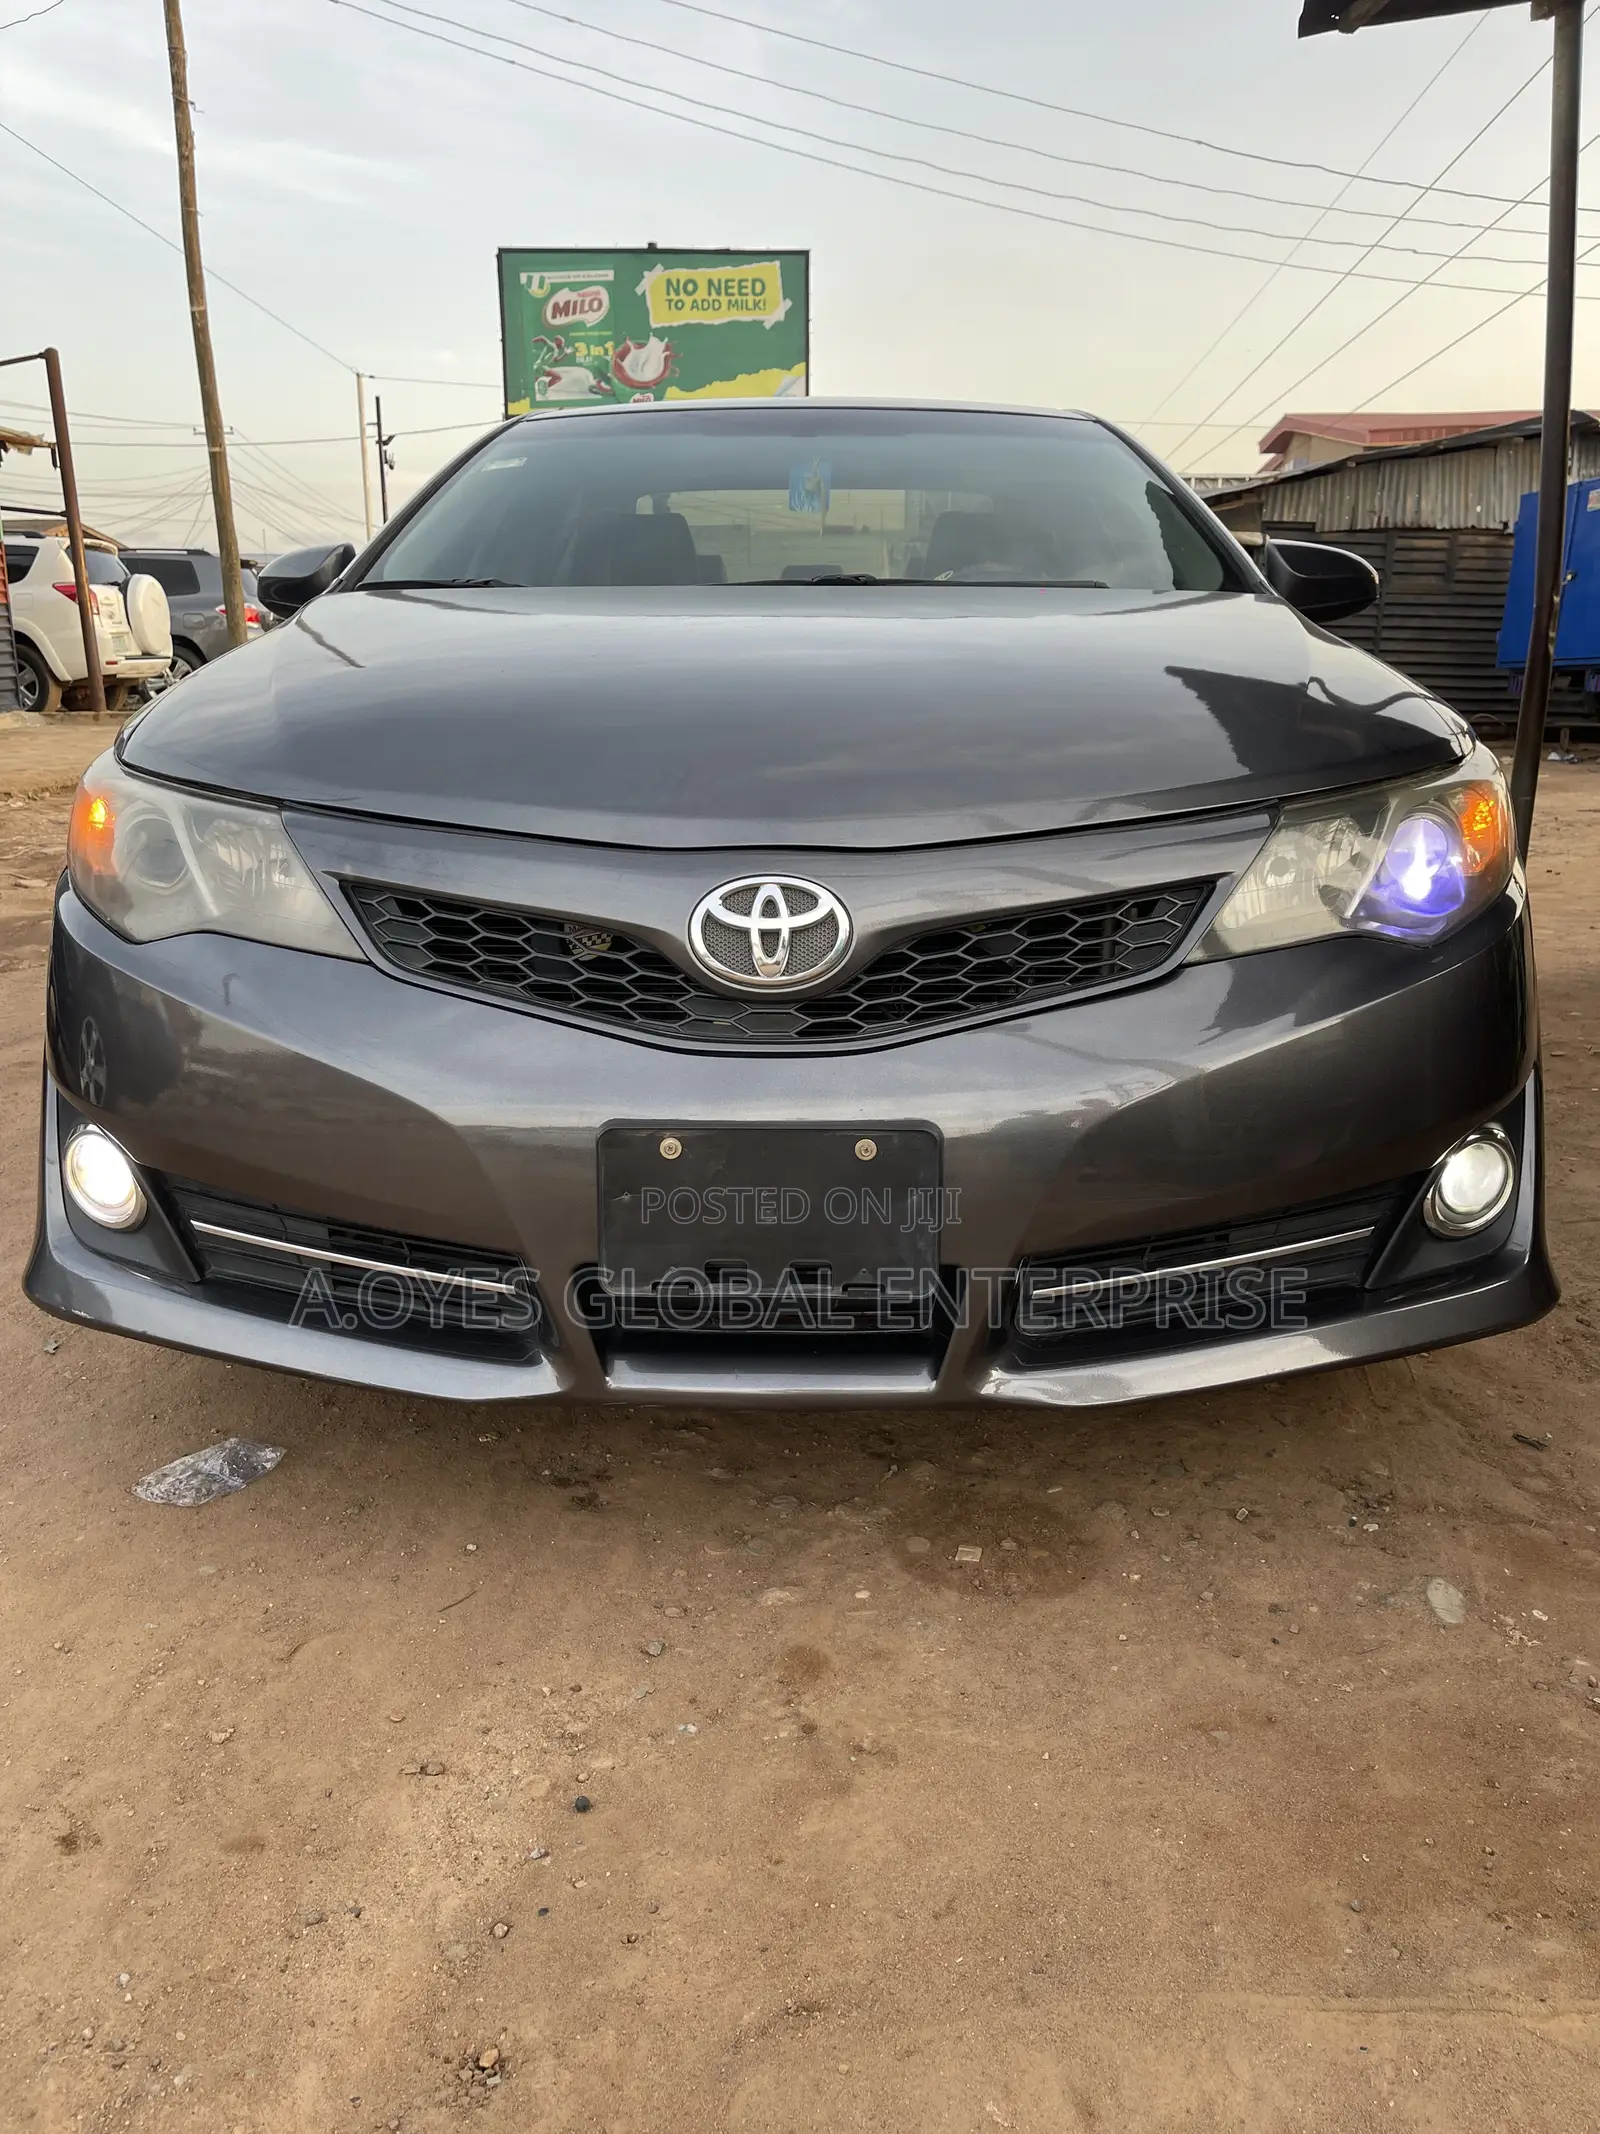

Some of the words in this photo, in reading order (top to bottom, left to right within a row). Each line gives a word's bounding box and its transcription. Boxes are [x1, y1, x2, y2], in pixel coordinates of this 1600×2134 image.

[665, 278, 698, 296] NO
[707, 278, 766, 296] NEED
[551, 296, 603, 320] MILO
[665, 299, 685, 311] TO
[690, 298, 722, 311] ADD
[727, 298, 766, 311] MILK!
